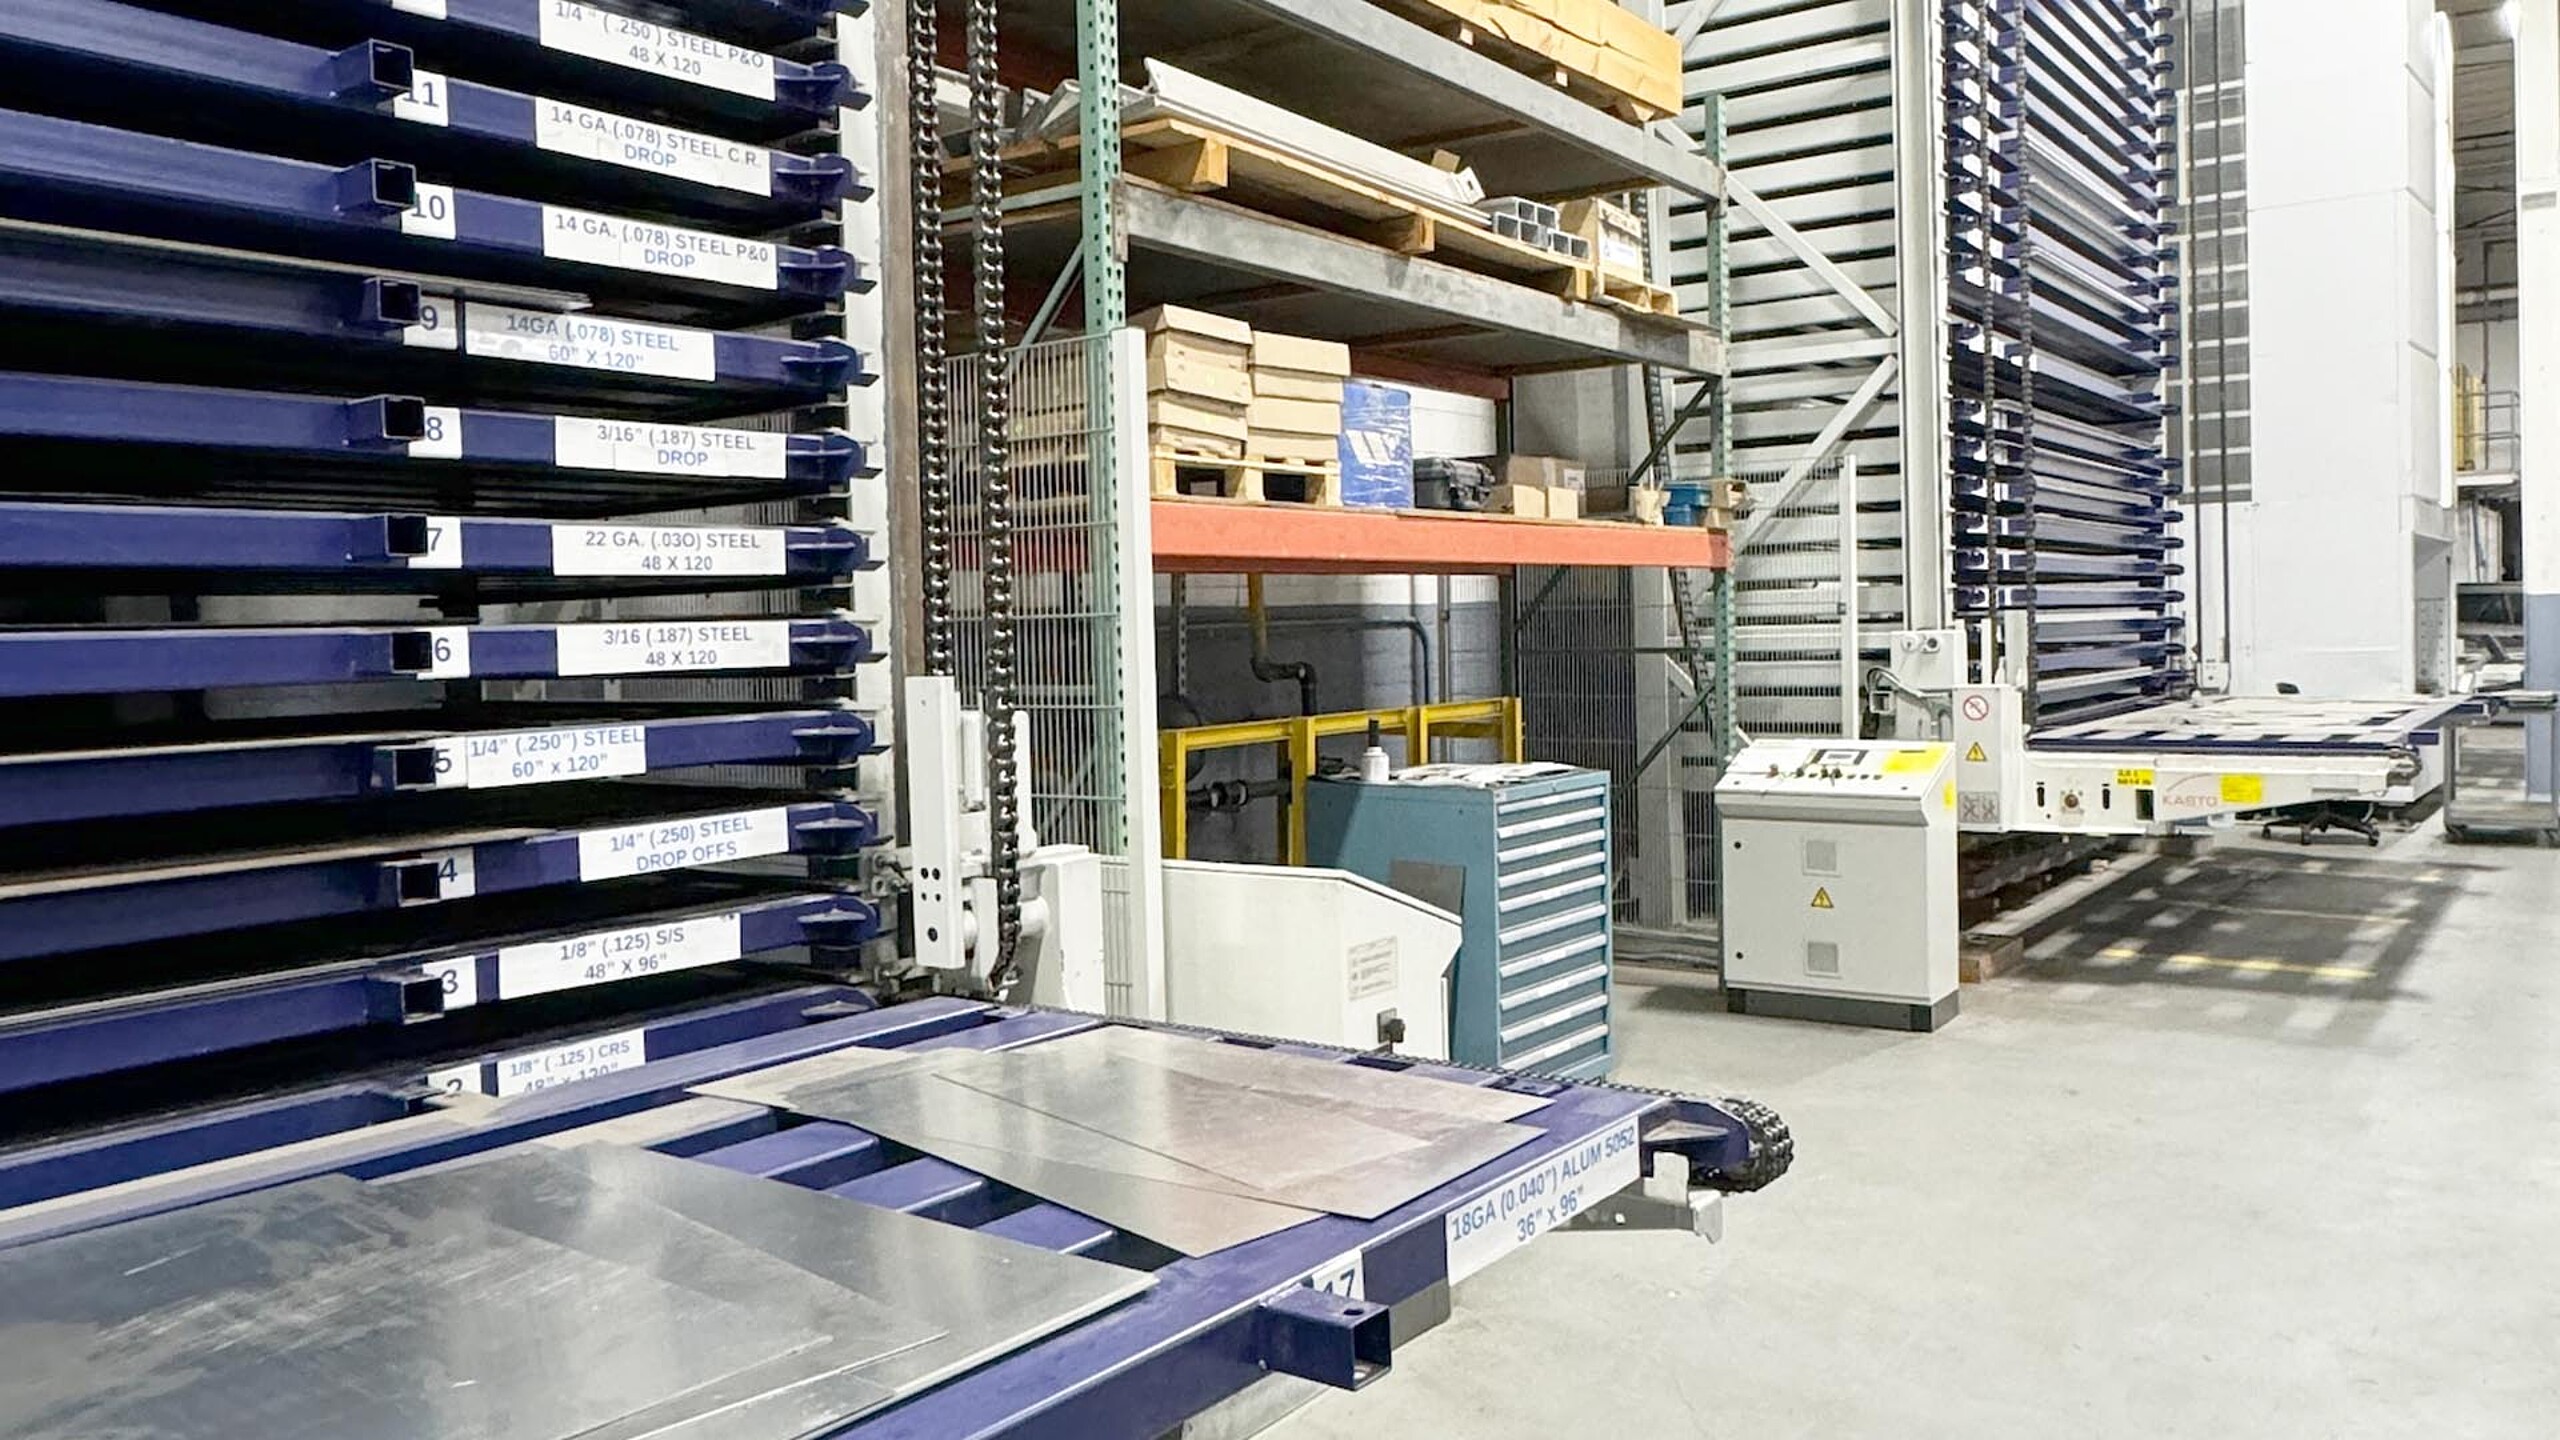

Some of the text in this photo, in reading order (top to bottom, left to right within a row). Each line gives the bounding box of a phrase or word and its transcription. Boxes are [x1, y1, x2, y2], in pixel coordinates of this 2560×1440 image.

[667, 32, 724, 59] STEEL
[628, 45, 702, 76] 48 X 120
[550, 106, 573, 125] 14
[666, 132, 724, 159] STEEL
[623, 143, 677, 169] DROP
[410, 192, 446, 221] 10
[554, 213, 578, 232] 14
[582, 217, 618, 240] GA.
[622, 223, 671, 250] (.078)
[675, 233, 733, 258] STEEL
[643, 248, 696, 269] DROP
[420, 304, 438, 332] 9
[506, 313, 680, 352] 14GA (.078) STEEL
[586, 349, 599, 365] X
[604, 350, 645, 370] 120"
[426, 415, 444, 442] 8
[597, 424, 757, 451] 3/16" (.187) STEEL
[657, 449, 709, 468] DROP
[426, 526, 443, 552] 7
[585, 530, 607, 548] 22
[612, 530, 646, 548] GA.
[706, 532, 761, 550] STEEL
[640, 554, 714, 571] 48 X 120
[603, 628, 641, 646] 3/16
[698, 625, 754, 643] STEEL
[434, 636, 452, 663] 6
[644, 649, 718, 667] 48 X 120
[469, 736, 508, 758] 1/4"
[583, 725, 644, 747] STEEL
[434, 747, 453, 774] 5
[511, 759, 544, 778] 60"
[567, 752, 608, 773] 120"
[610, 815, 754, 852] 1/4" (.250) STEEL
[636, 840, 738, 872] DROP OFFS
[438, 857, 459, 883] 4
[559, 926, 685, 962] 1/8" (.125) S/S
[584, 960, 615, 980] 48"
[639, 952, 668, 972] 96"
[440, 968, 460, 995] 3
[598, 1039, 631, 1058] CRS
[447, 1077, 463, 1092] 2
[1451, 1203, 1497, 1242] 18GA
[1560, 1145, 1603, 1182] ALUM
[1604, 1124, 1636, 1159] 5052
[1516, 1208, 1544, 1242] 36"
[1560, 1184, 1585, 1218] 96"
